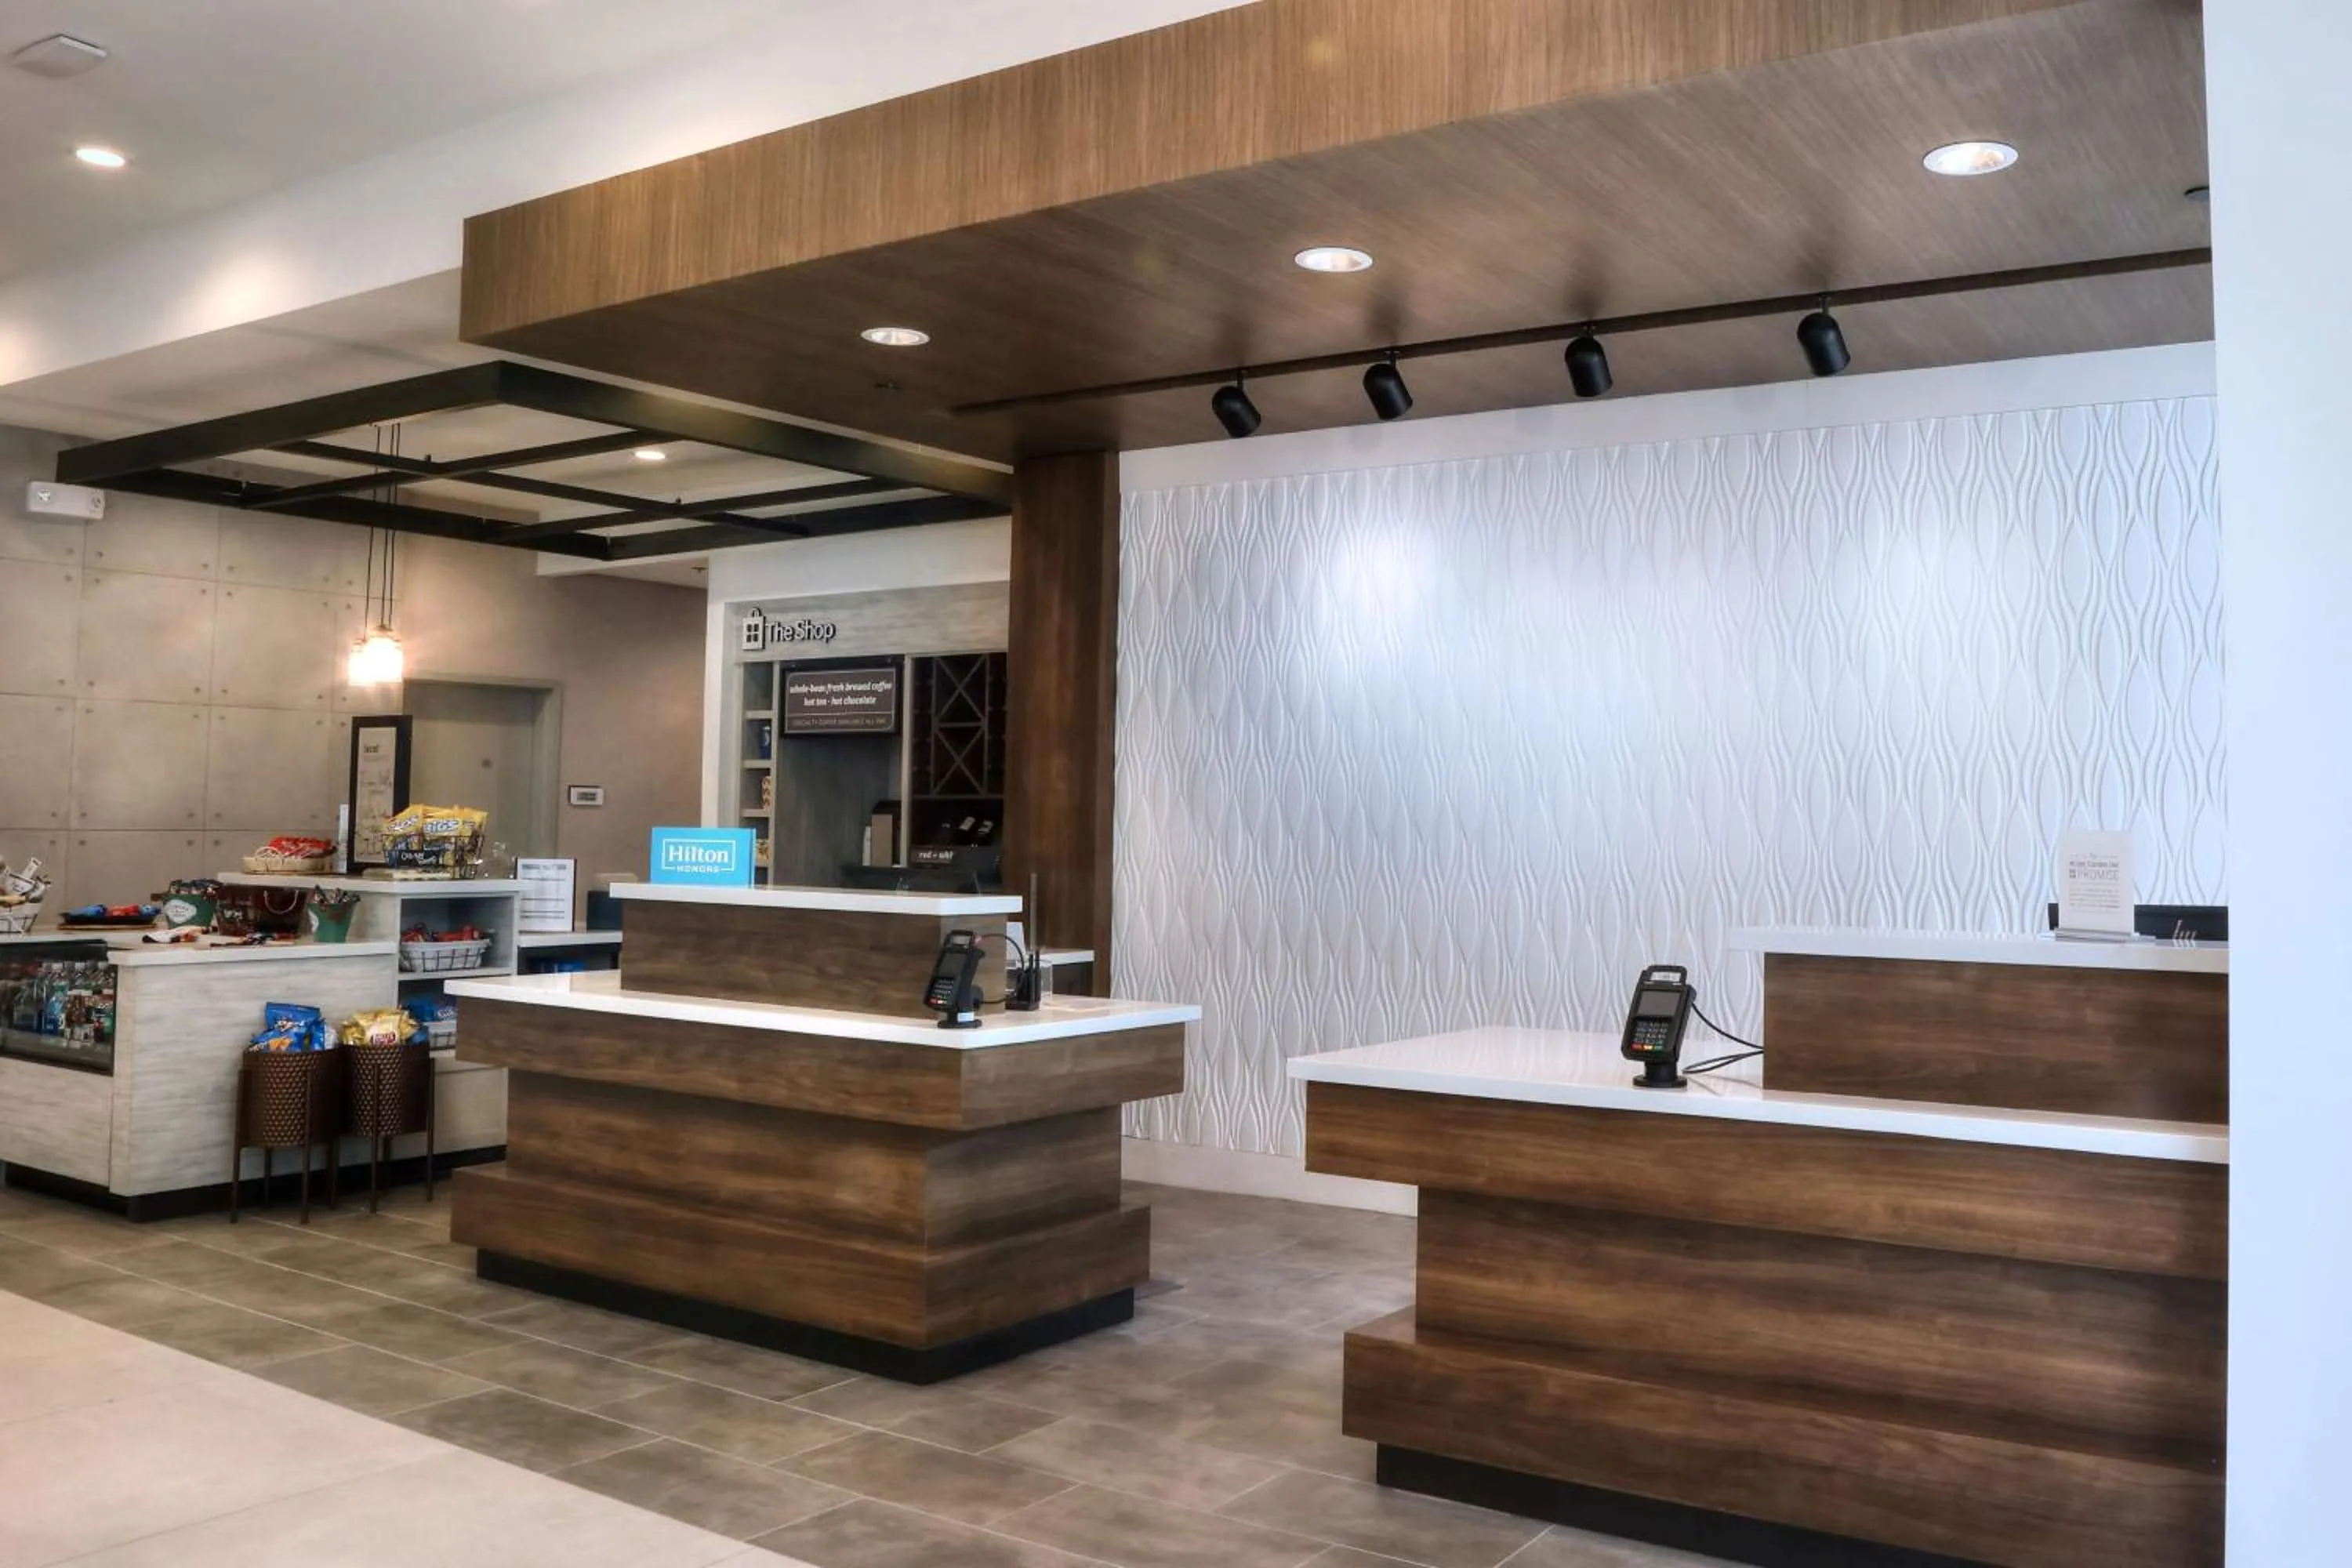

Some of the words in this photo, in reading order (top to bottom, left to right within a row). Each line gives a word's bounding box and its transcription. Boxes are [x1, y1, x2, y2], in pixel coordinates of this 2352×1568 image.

[765, 622, 794, 643] The
[795, 619, 837, 644] Shop
[872, 681, 892, 692] coffee
[668, 844, 728, 863] Hilton
[2078, 869, 2119, 880] PROMISE
